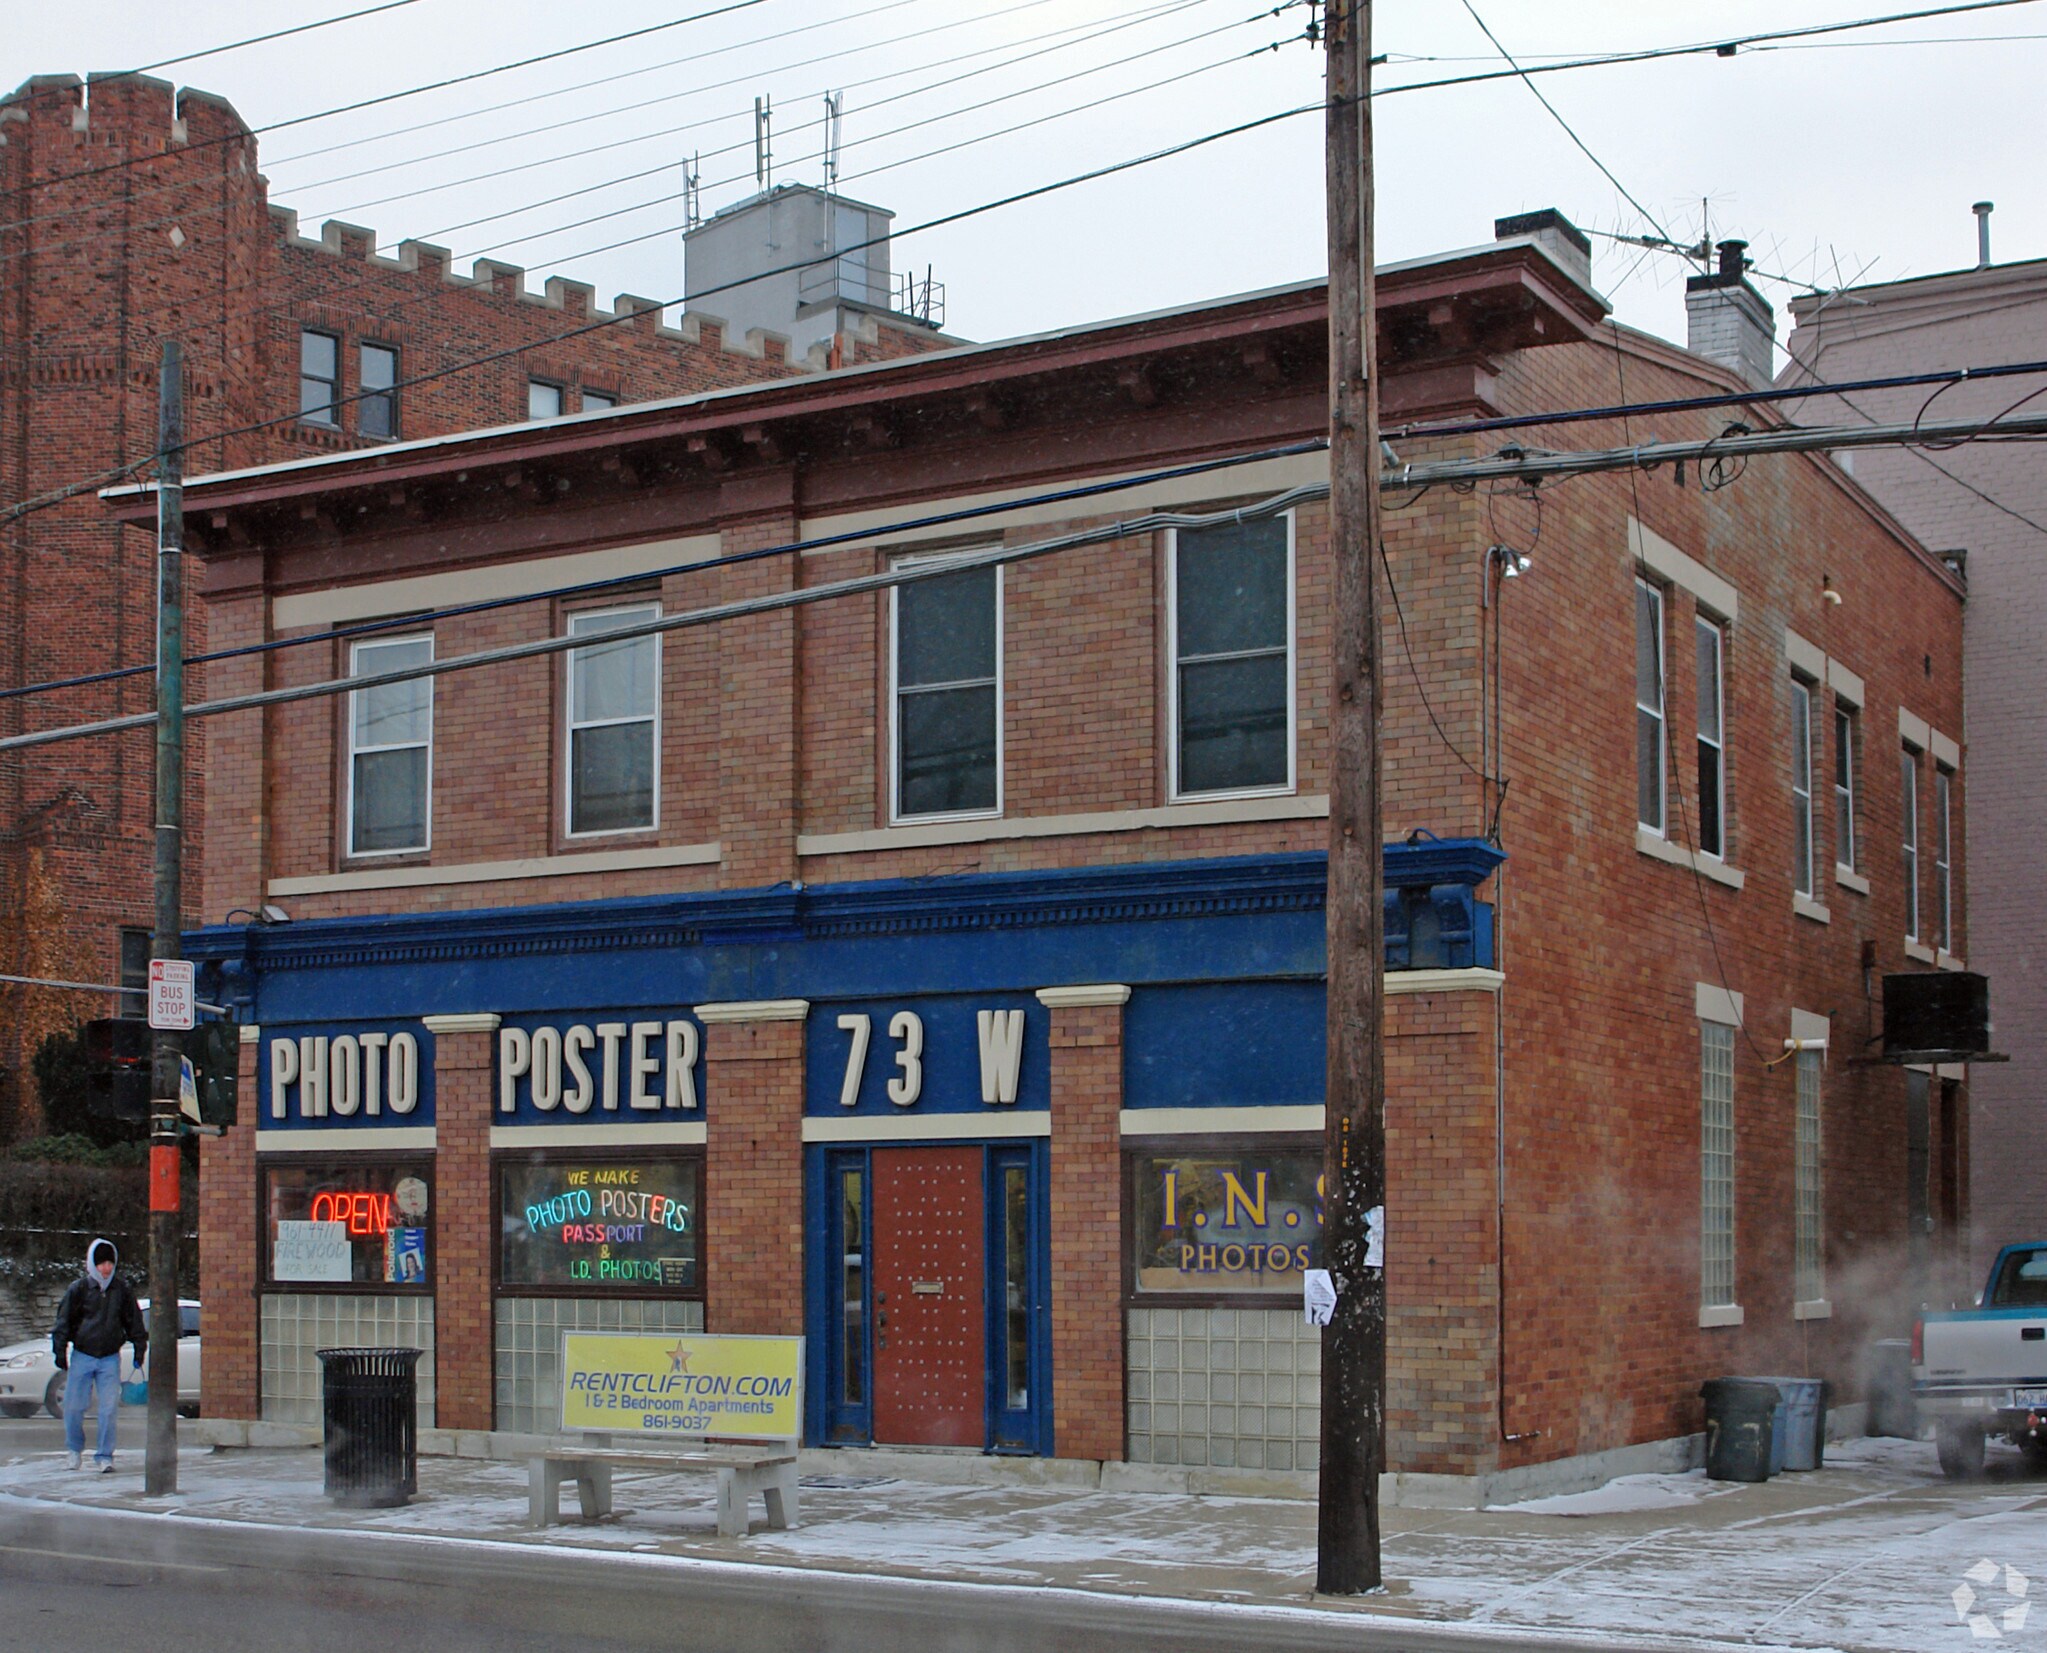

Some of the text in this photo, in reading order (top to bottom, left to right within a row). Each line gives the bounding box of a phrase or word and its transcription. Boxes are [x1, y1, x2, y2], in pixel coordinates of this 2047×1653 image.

[160, 985, 183, 999] BUS
[157, 1001, 186, 1015] STOP
[977, 1009, 1025, 1104] W
[271, 1020, 699, 1119] PHOTO POSTER
[568, 1169, 640, 1186] WE MAKE
[311, 1193, 390, 1234] OPEN
[526, 1189, 688, 1233] PHOTO POSTERS
[562, 1224, 645, 1244] PASSPORT
[387, 1229, 396, 1282] Polaroid
[600, 1244, 611, 1259] &
[1179, 1243, 1313, 1273] PHOTOS
[600, 1259, 660, 1281] PHOTOS
[570, 1372, 792, 1397] RENTCLIFTON.COM
[594, 1394, 605, 1408] &
[607, 1395, 617, 1409] 2
[621, 1396, 684, 1412] Bedroom
[688, 1397, 774, 1415] Apartments
[643, 1414, 712, 1431] 861-9037
